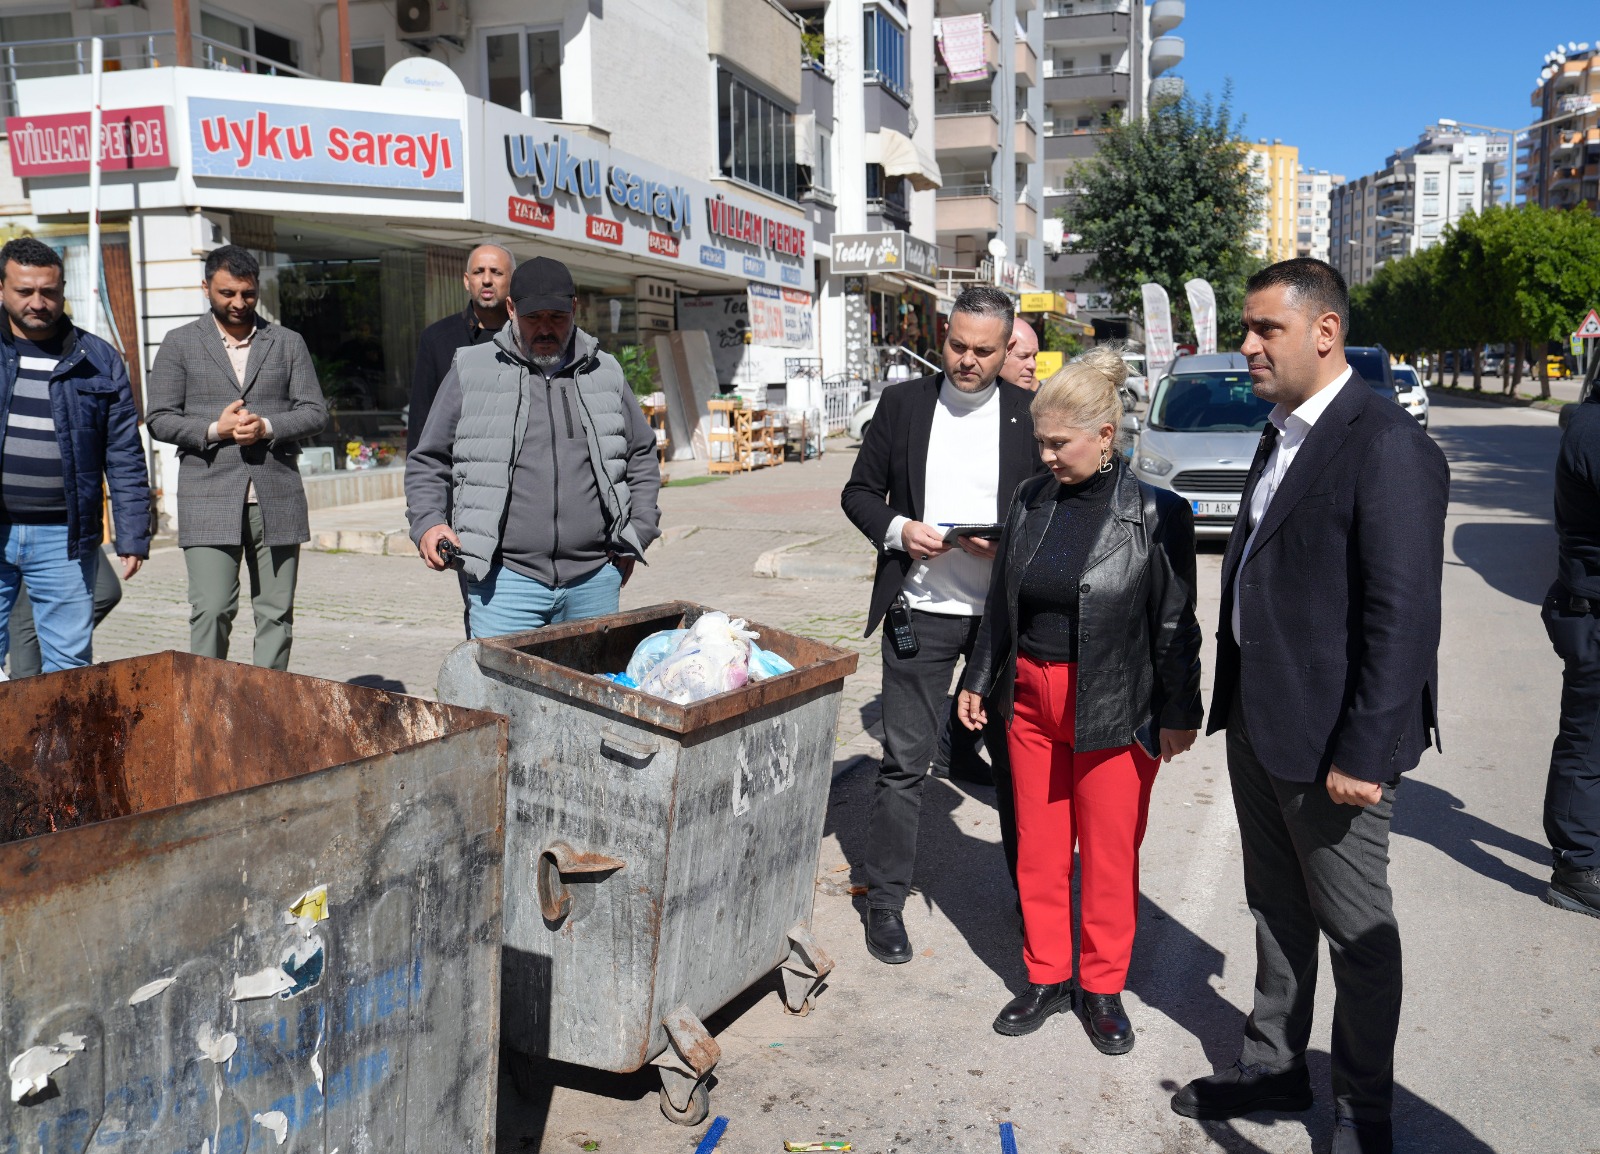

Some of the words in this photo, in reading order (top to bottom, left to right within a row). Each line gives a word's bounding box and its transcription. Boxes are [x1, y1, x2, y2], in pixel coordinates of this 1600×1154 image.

[11, 121, 91, 165] VİLLAM
[200, 110, 314, 169] uyku
[326, 126, 453, 181] sarayı
[506, 134, 602, 199] uyku
[606, 165, 692, 233] sarayı
[513, 200, 551, 224] YATAK
[707, 194, 762, 247] VİLLAM
[766, 219, 806, 258] PERDE
[591, 220, 618, 240] BAZA
[835, 241, 874, 268] Teddy
[906, 241, 925, 274] Teddy
[1198, 503, 1209, 513] 01
[1215, 503, 1232, 513] ABK
